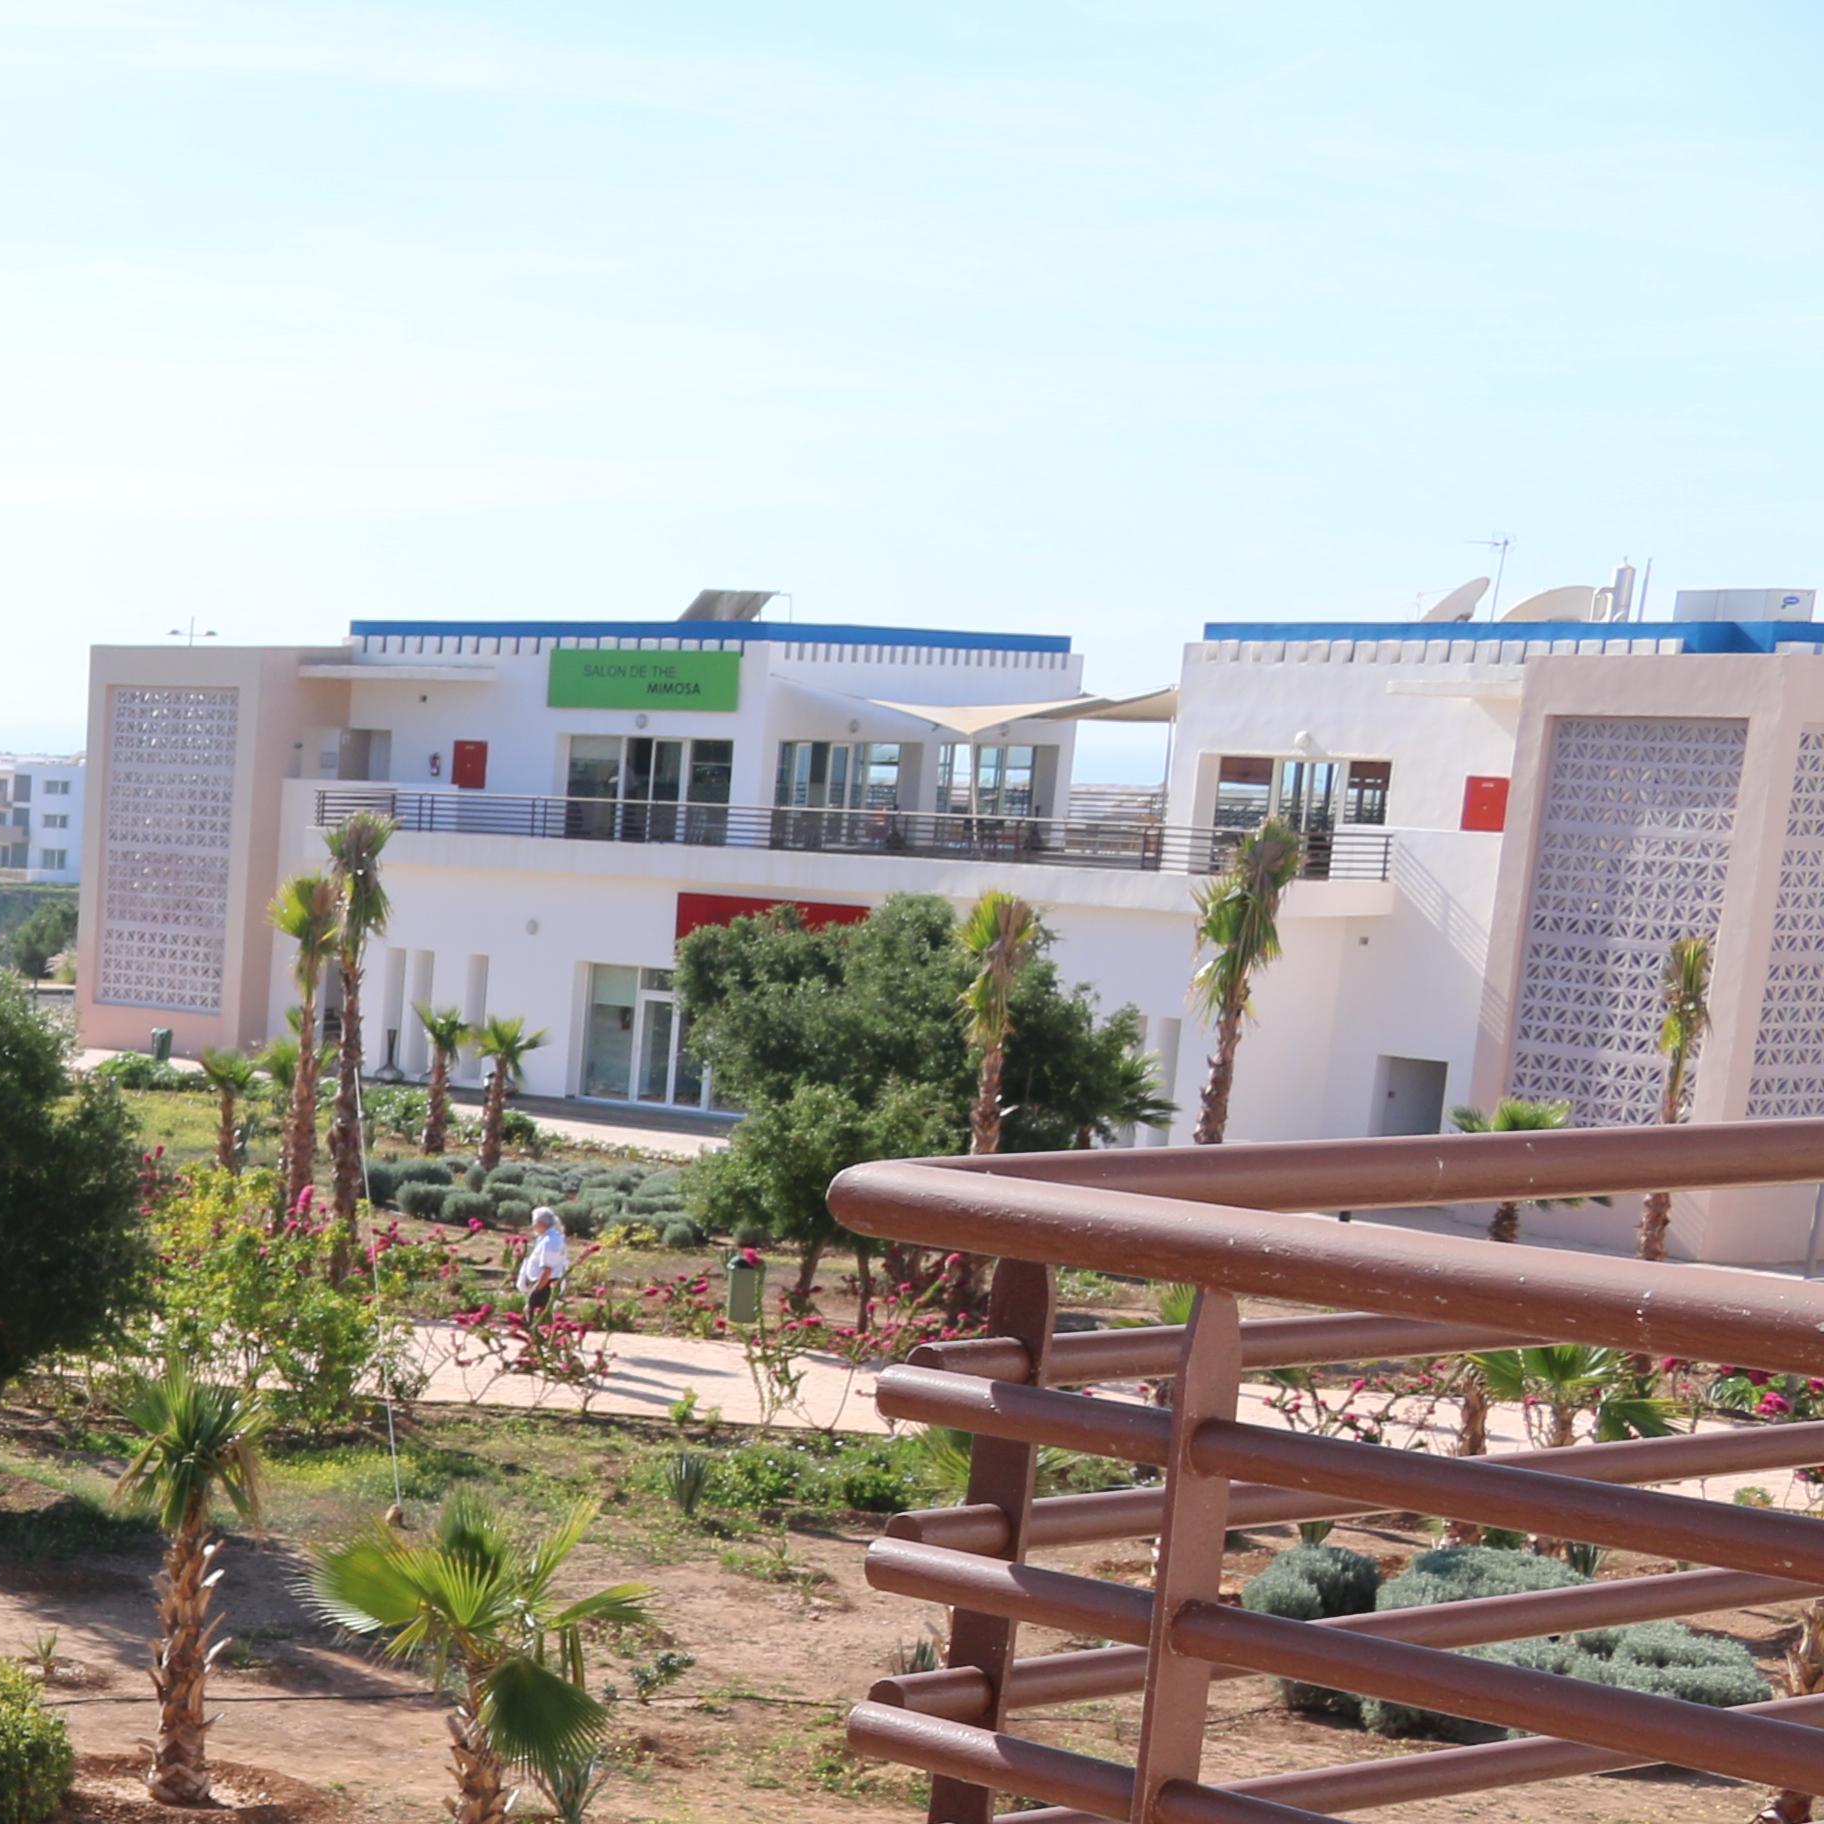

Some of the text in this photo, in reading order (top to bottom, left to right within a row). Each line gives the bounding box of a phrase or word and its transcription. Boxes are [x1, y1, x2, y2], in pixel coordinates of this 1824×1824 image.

[583, 664, 677, 679] SALON DE THE
[647, 682, 701, 695] MIMOSA
